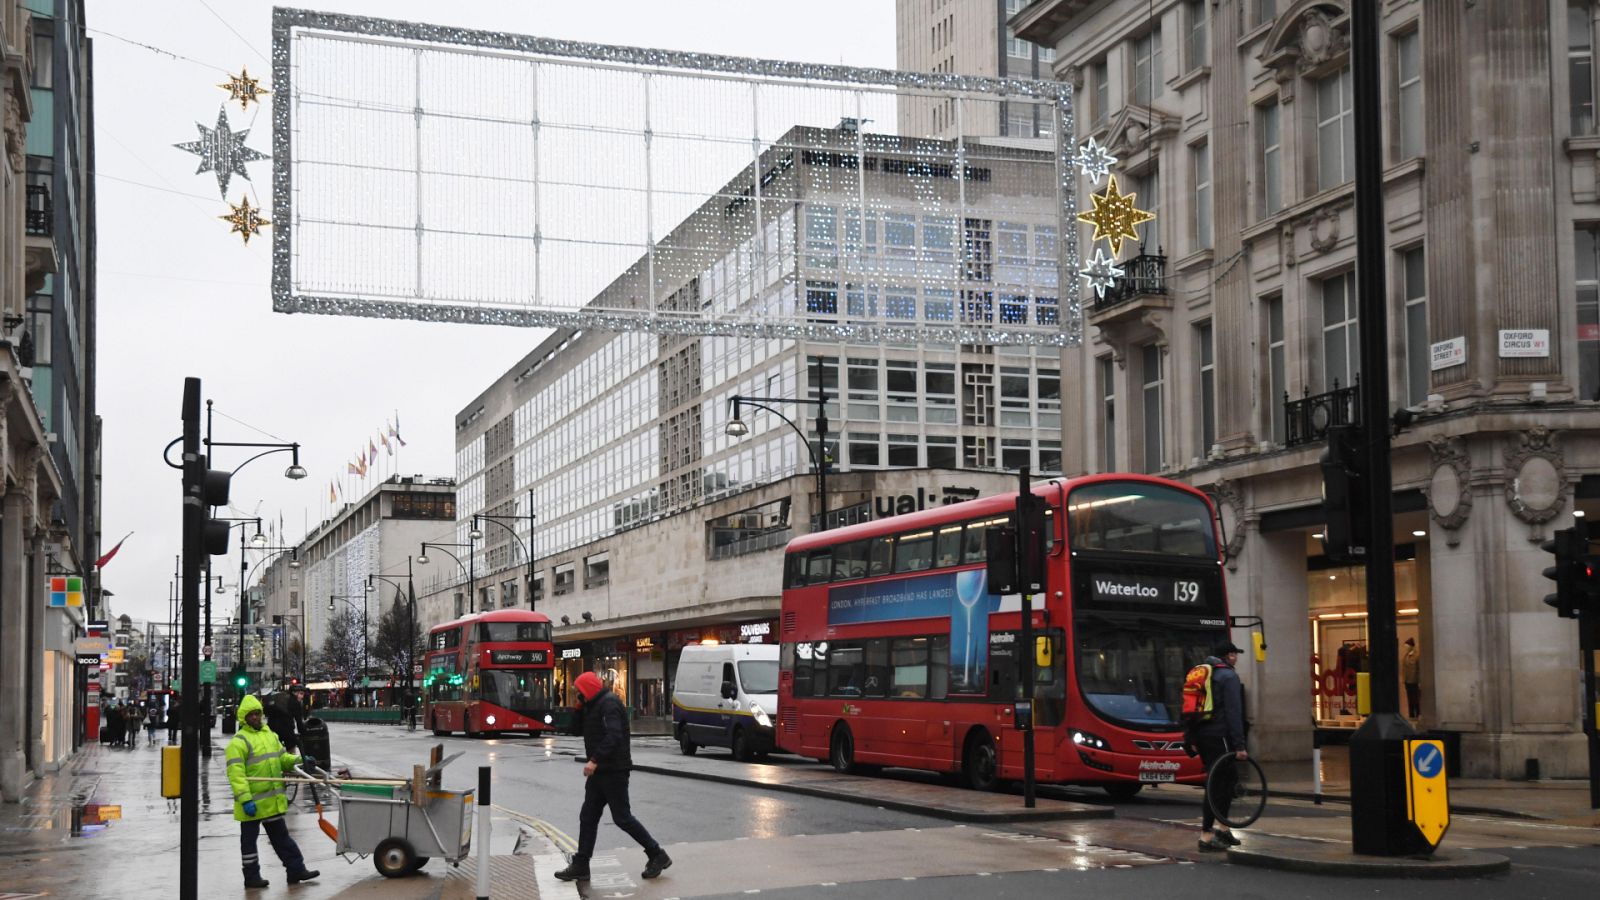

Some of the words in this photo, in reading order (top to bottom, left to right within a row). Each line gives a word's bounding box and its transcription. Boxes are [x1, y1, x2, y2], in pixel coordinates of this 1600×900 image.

[1504, 332, 1533, 340] OXFORD
[1433, 342, 1453, 353] OXFORD
[1433, 350, 1453, 361] STREET
[883, 592, 914, 604] BROADBAND
[916, 591, 927, 599] HAS
[930, 588, 953, 599] LANDED
[1096, 580, 1158, 597] Waterloo
[1174, 581, 1199, 602] 139
[741, 622, 770, 636] SOUVENIRS
[990, 632, 1015, 643] Metroline
[532, 653, 543, 662] 390
[1139, 760, 1180, 770] Metroline
[1141, 772, 1158, 780] LK64
